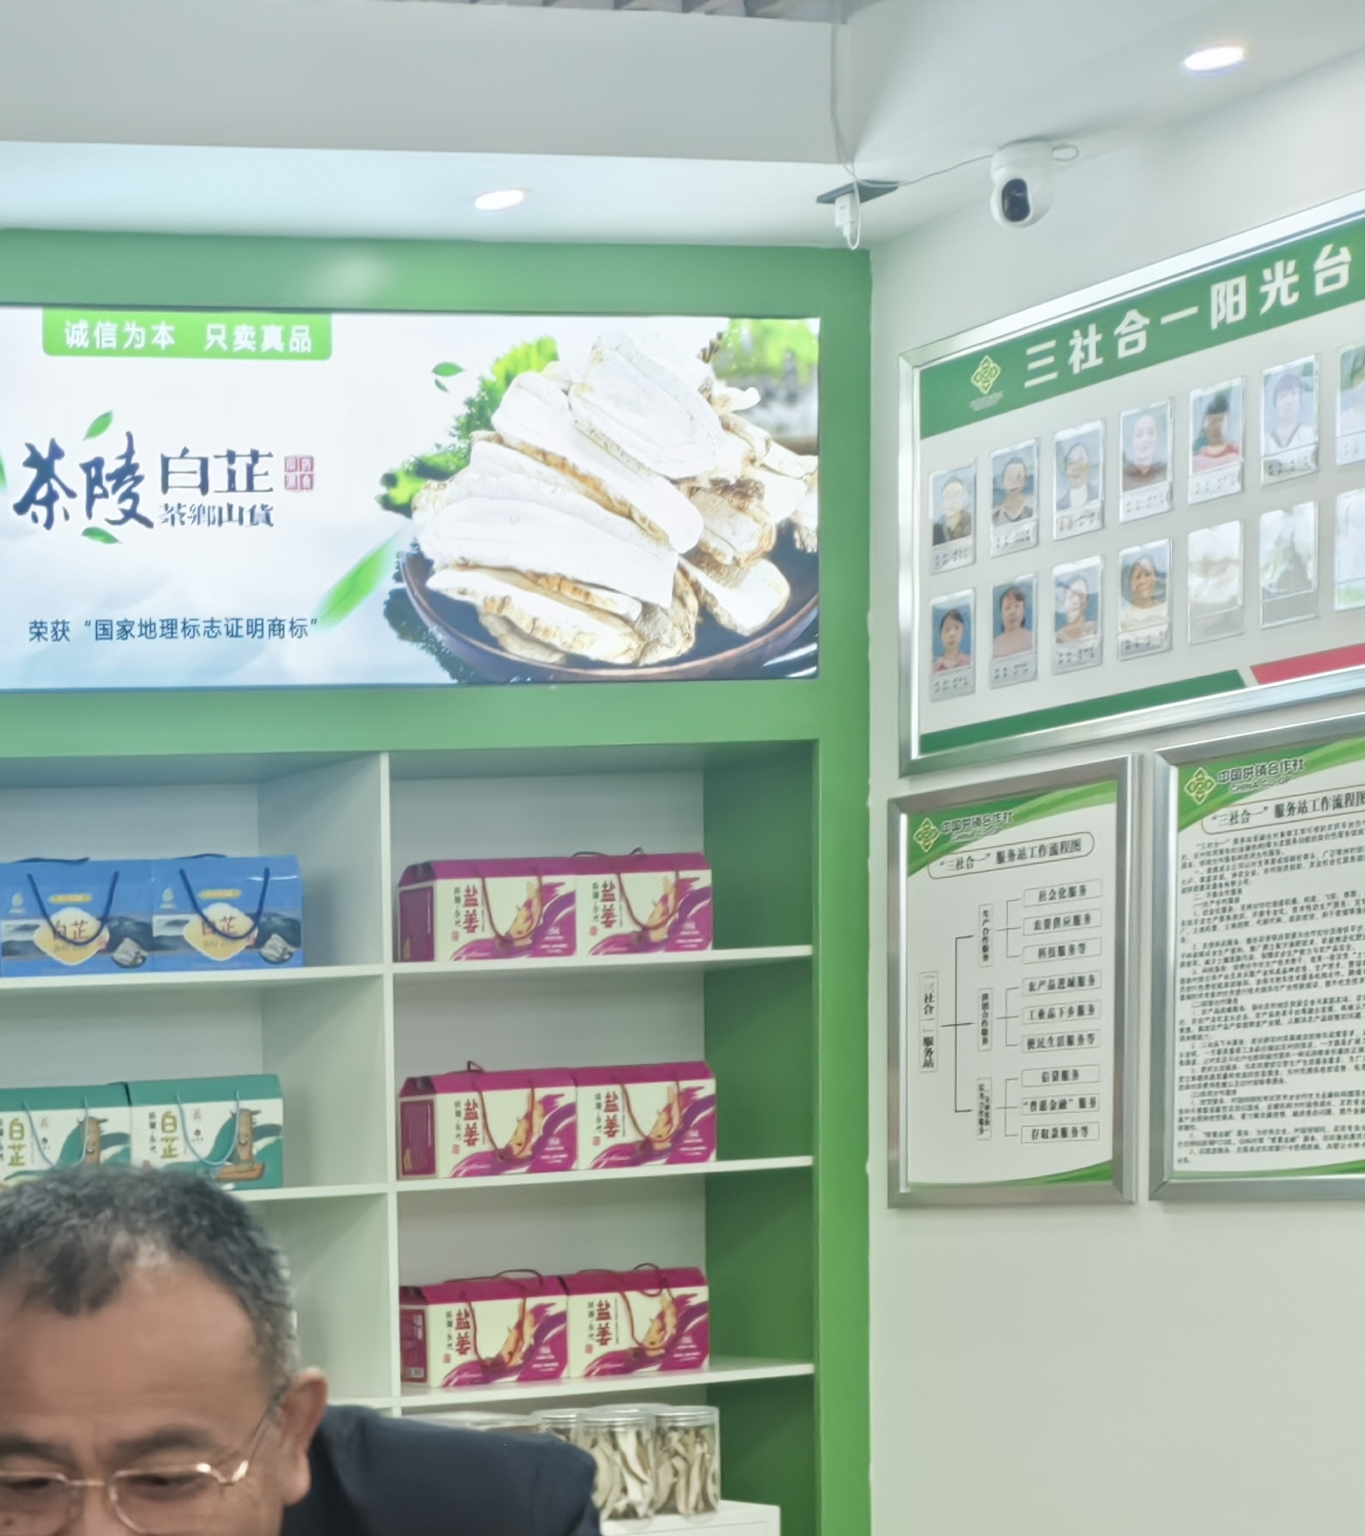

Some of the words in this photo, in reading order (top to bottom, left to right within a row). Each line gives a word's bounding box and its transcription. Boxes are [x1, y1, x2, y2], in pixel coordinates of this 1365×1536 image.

[63, 320, 176, 350] 诚信为本
[203, 324, 313, 354] 只卖真品
[1024, 243, 1352, 389] 三社合一阳光台
[12, 431, 154, 530] 茶陵
[159, 447, 274, 495] 白芷
[9, 1118, 26, 1167] 白芷
[161, 1110, 179, 1159] 白芷
[595, 1299, 612, 1347] 盐姜
